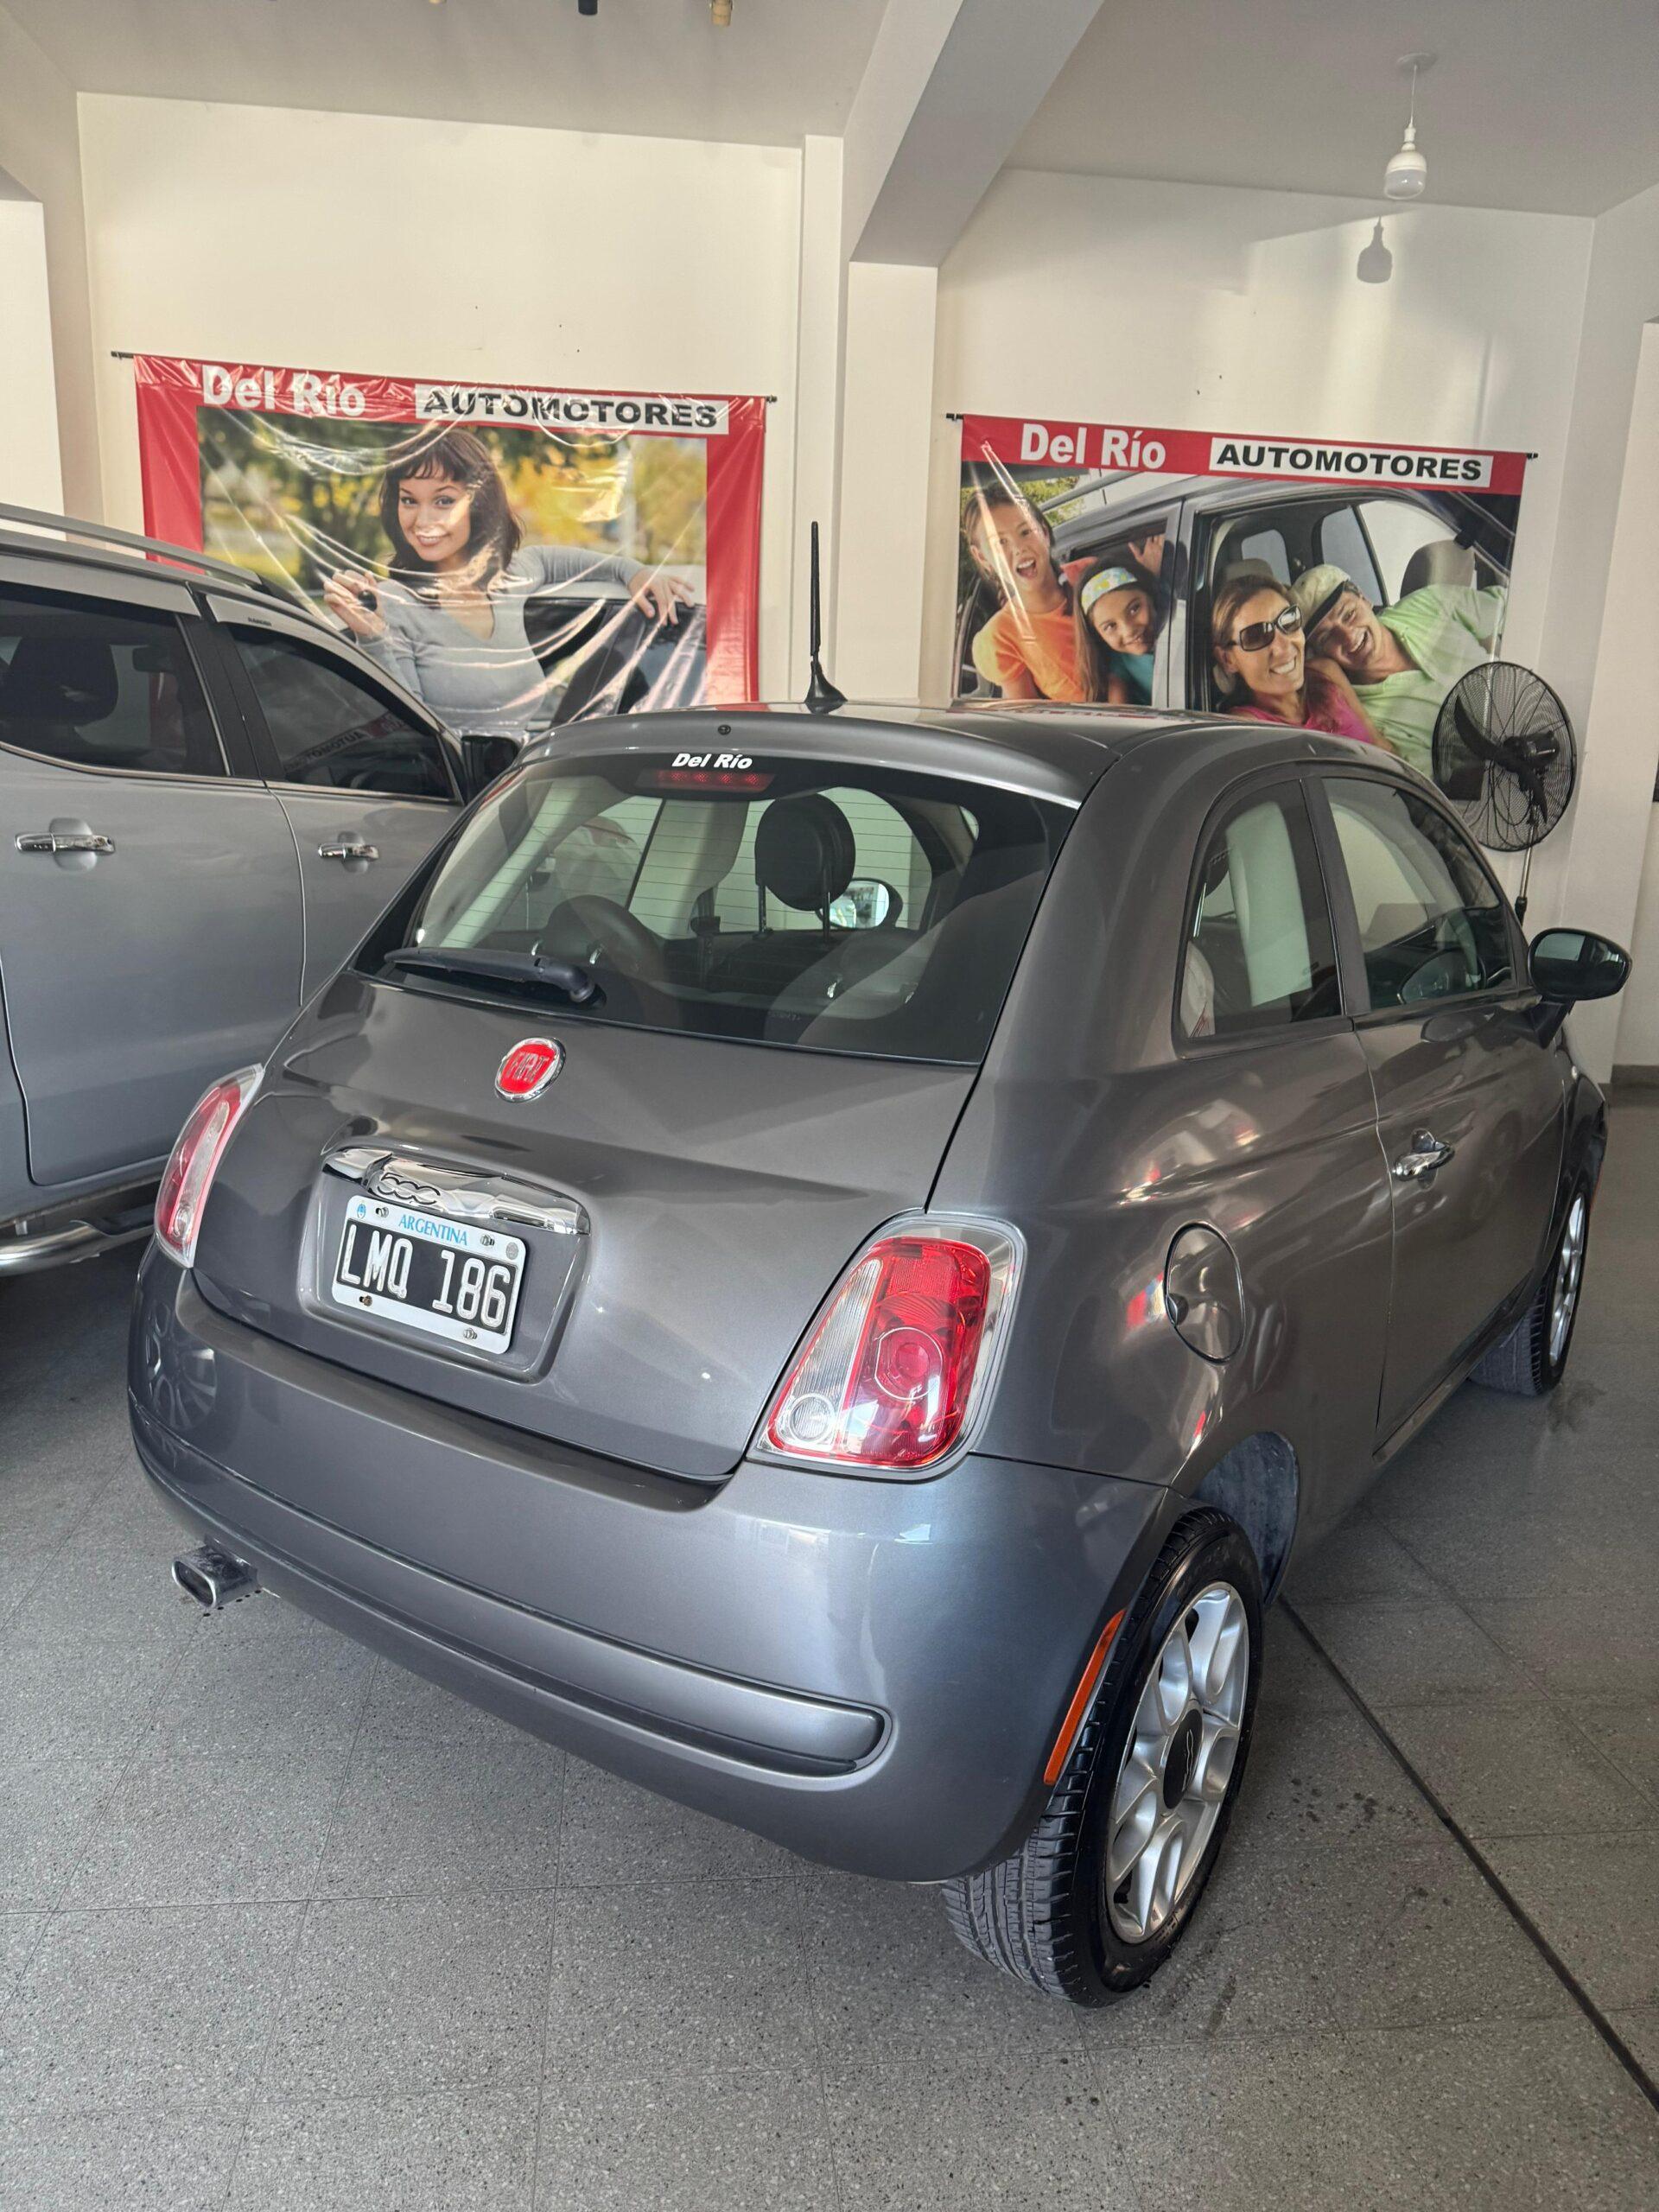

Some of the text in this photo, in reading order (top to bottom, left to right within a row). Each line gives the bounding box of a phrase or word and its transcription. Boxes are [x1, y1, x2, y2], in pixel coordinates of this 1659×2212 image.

[202, 364, 276, 410] Del
[423, 390, 718, 428] AUTOMOTORES
[1020, 423, 1482, 481] Del Río AUTOMOTORES
[671, 753, 753, 769] Del Río
[505, 1051, 550, 1084] FIAT
[377, 1172, 442, 1205] 500
[398, 1213, 468, 1246] ARGENTINA
[340, 1224, 511, 1328] LMQ 186
